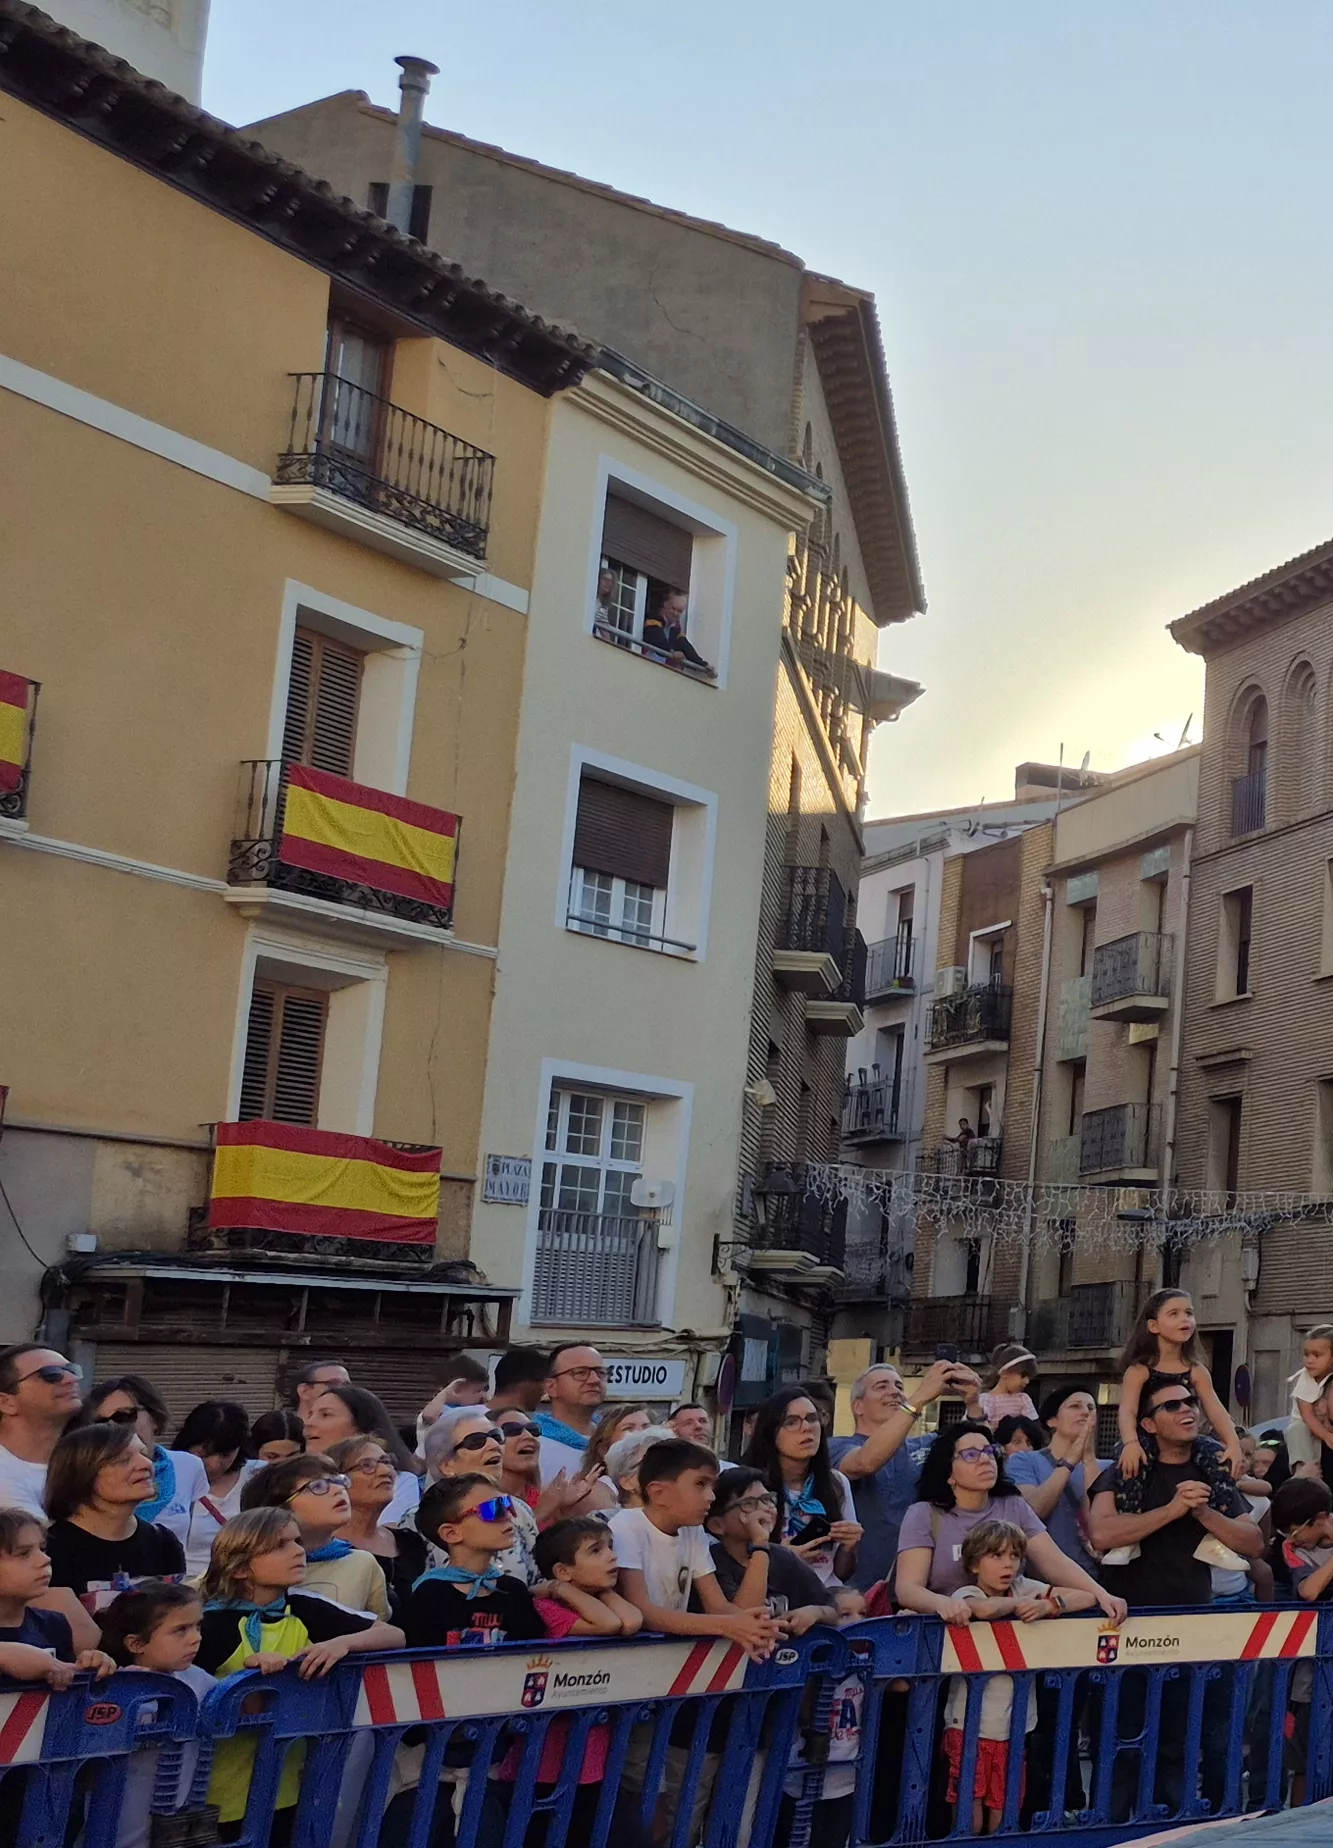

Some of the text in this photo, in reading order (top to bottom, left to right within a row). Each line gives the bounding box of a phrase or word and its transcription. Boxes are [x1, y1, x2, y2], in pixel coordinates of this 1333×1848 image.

[502, 1162, 528, 1177] PLAZA
[489, 1180, 527, 1199] MAYOR
[1125, 1634, 1179, 1648] Monzón
[777, 1651, 796, 1661] JSP
[553, 1670, 610, 1688] Monzón
[87, 1706, 118, 1720] JSP
